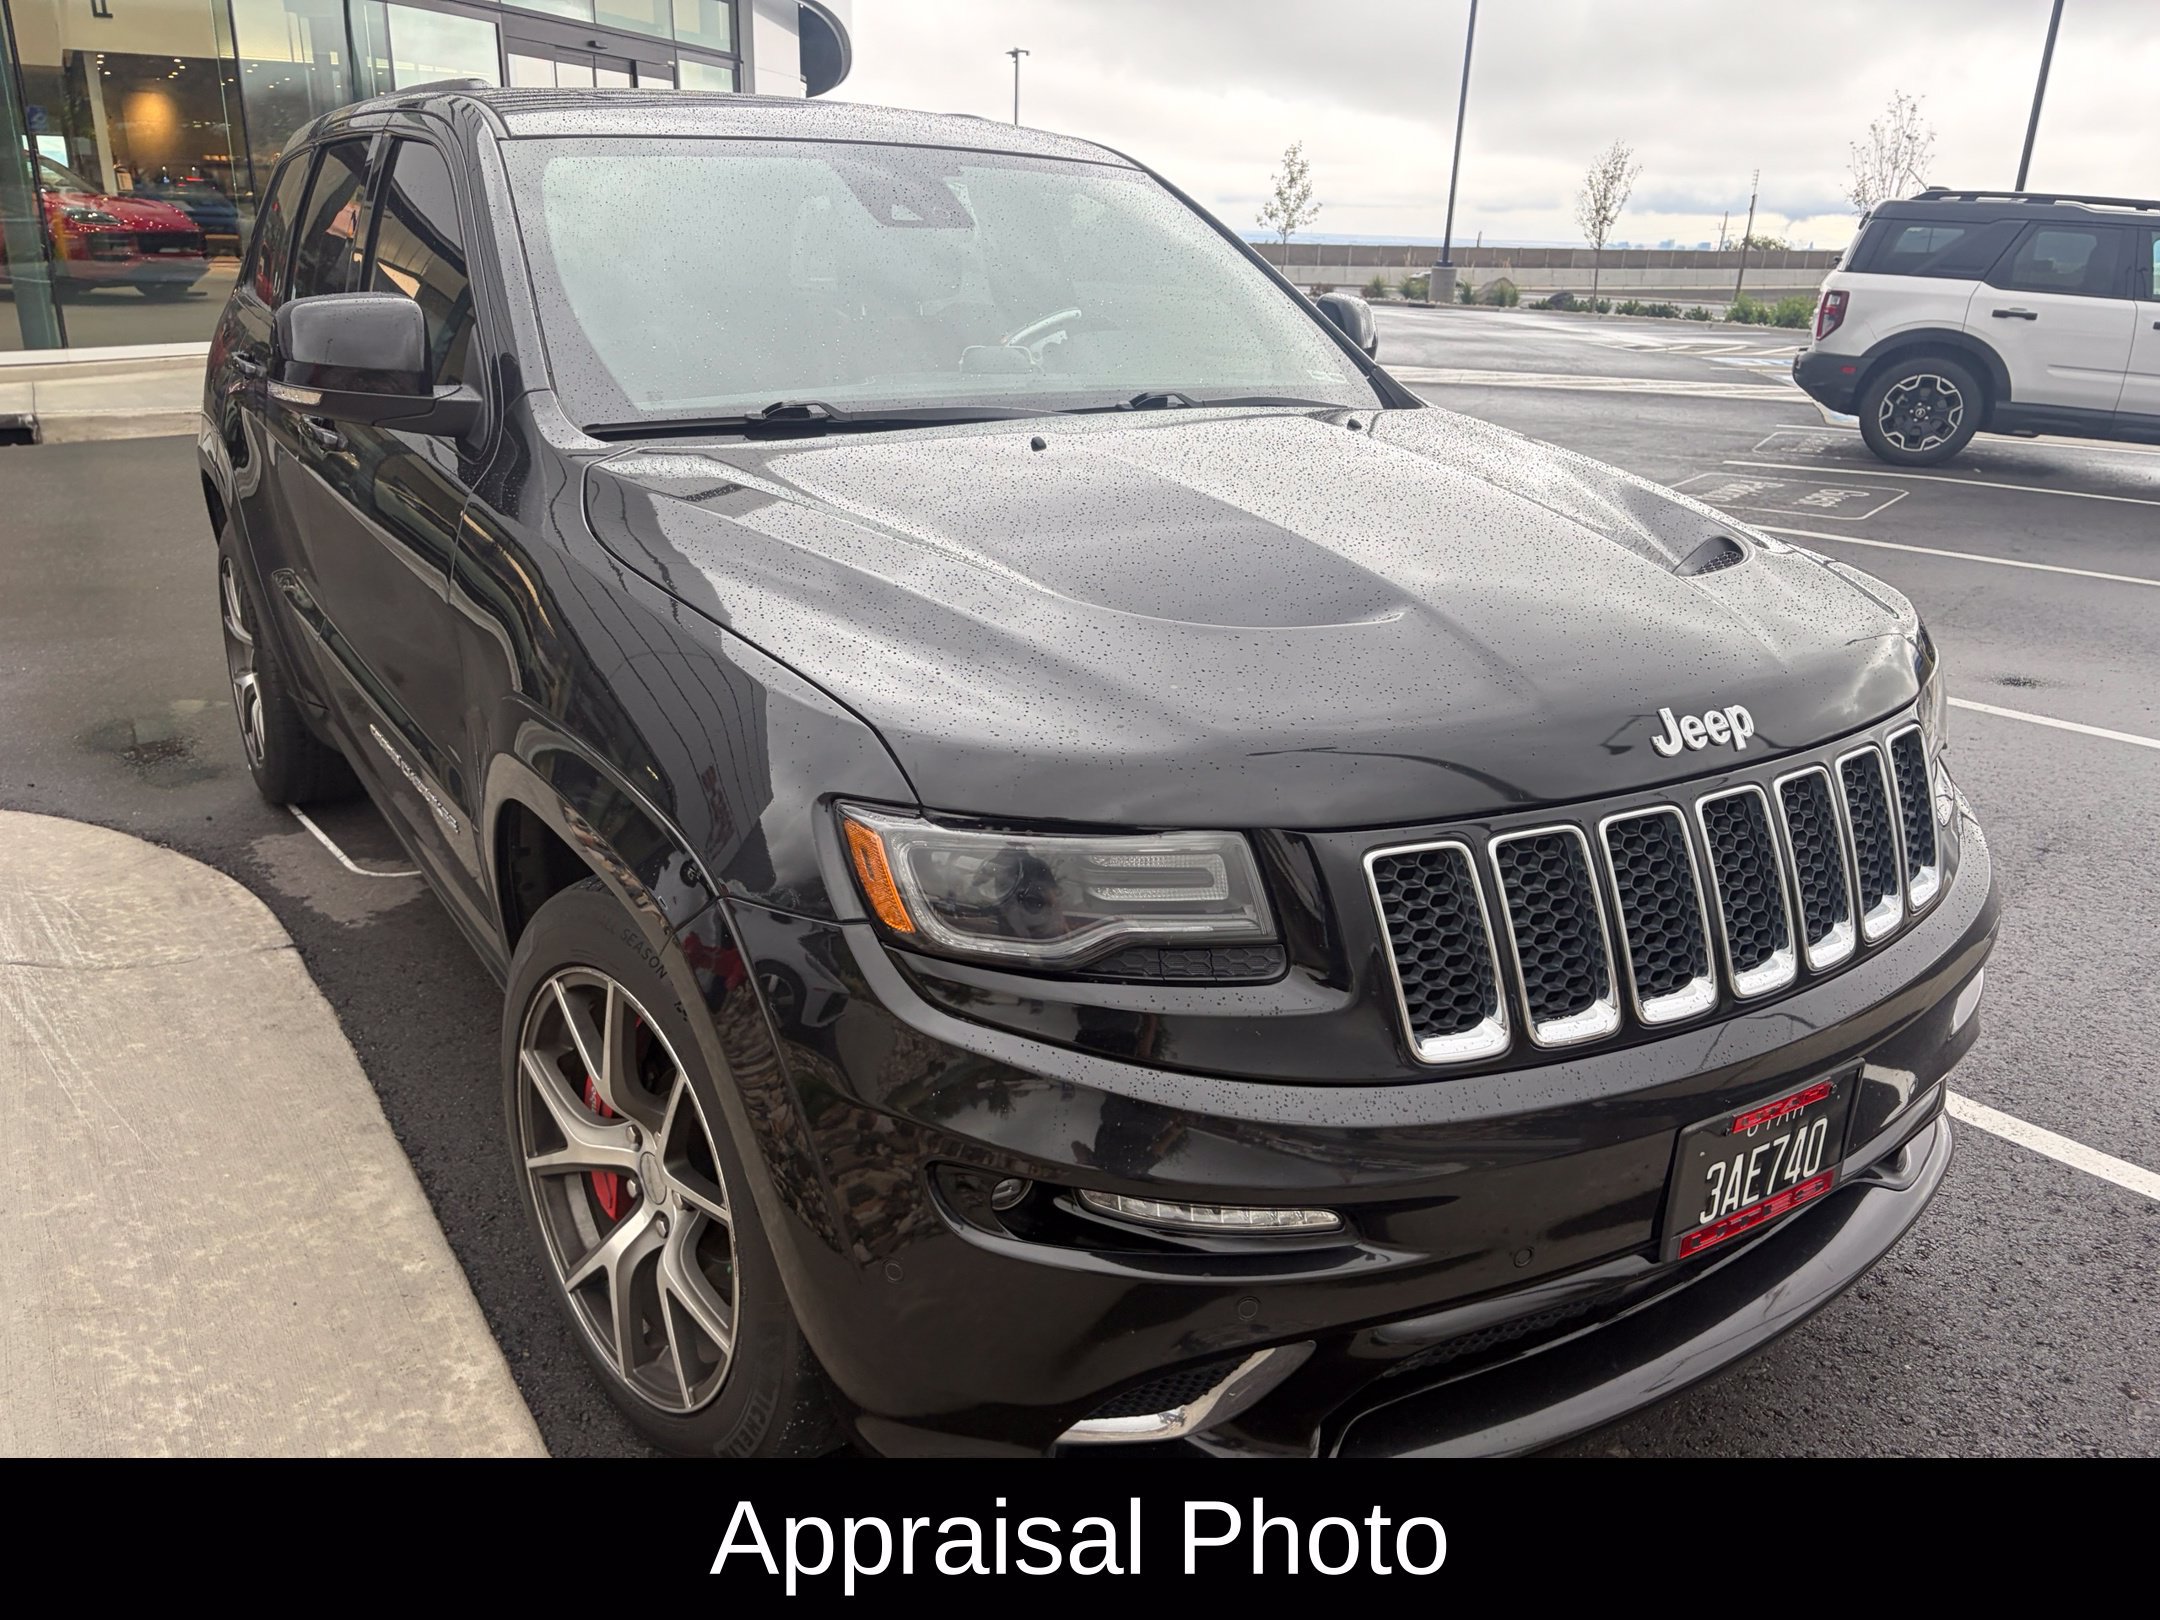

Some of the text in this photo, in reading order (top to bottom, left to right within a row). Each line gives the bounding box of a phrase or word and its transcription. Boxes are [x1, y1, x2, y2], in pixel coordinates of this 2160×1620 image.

[1651, 704, 1754, 758] Jeep
[620, 928, 668, 979] SEASON
[1699, 1117, 1828, 1225] 3AE740
